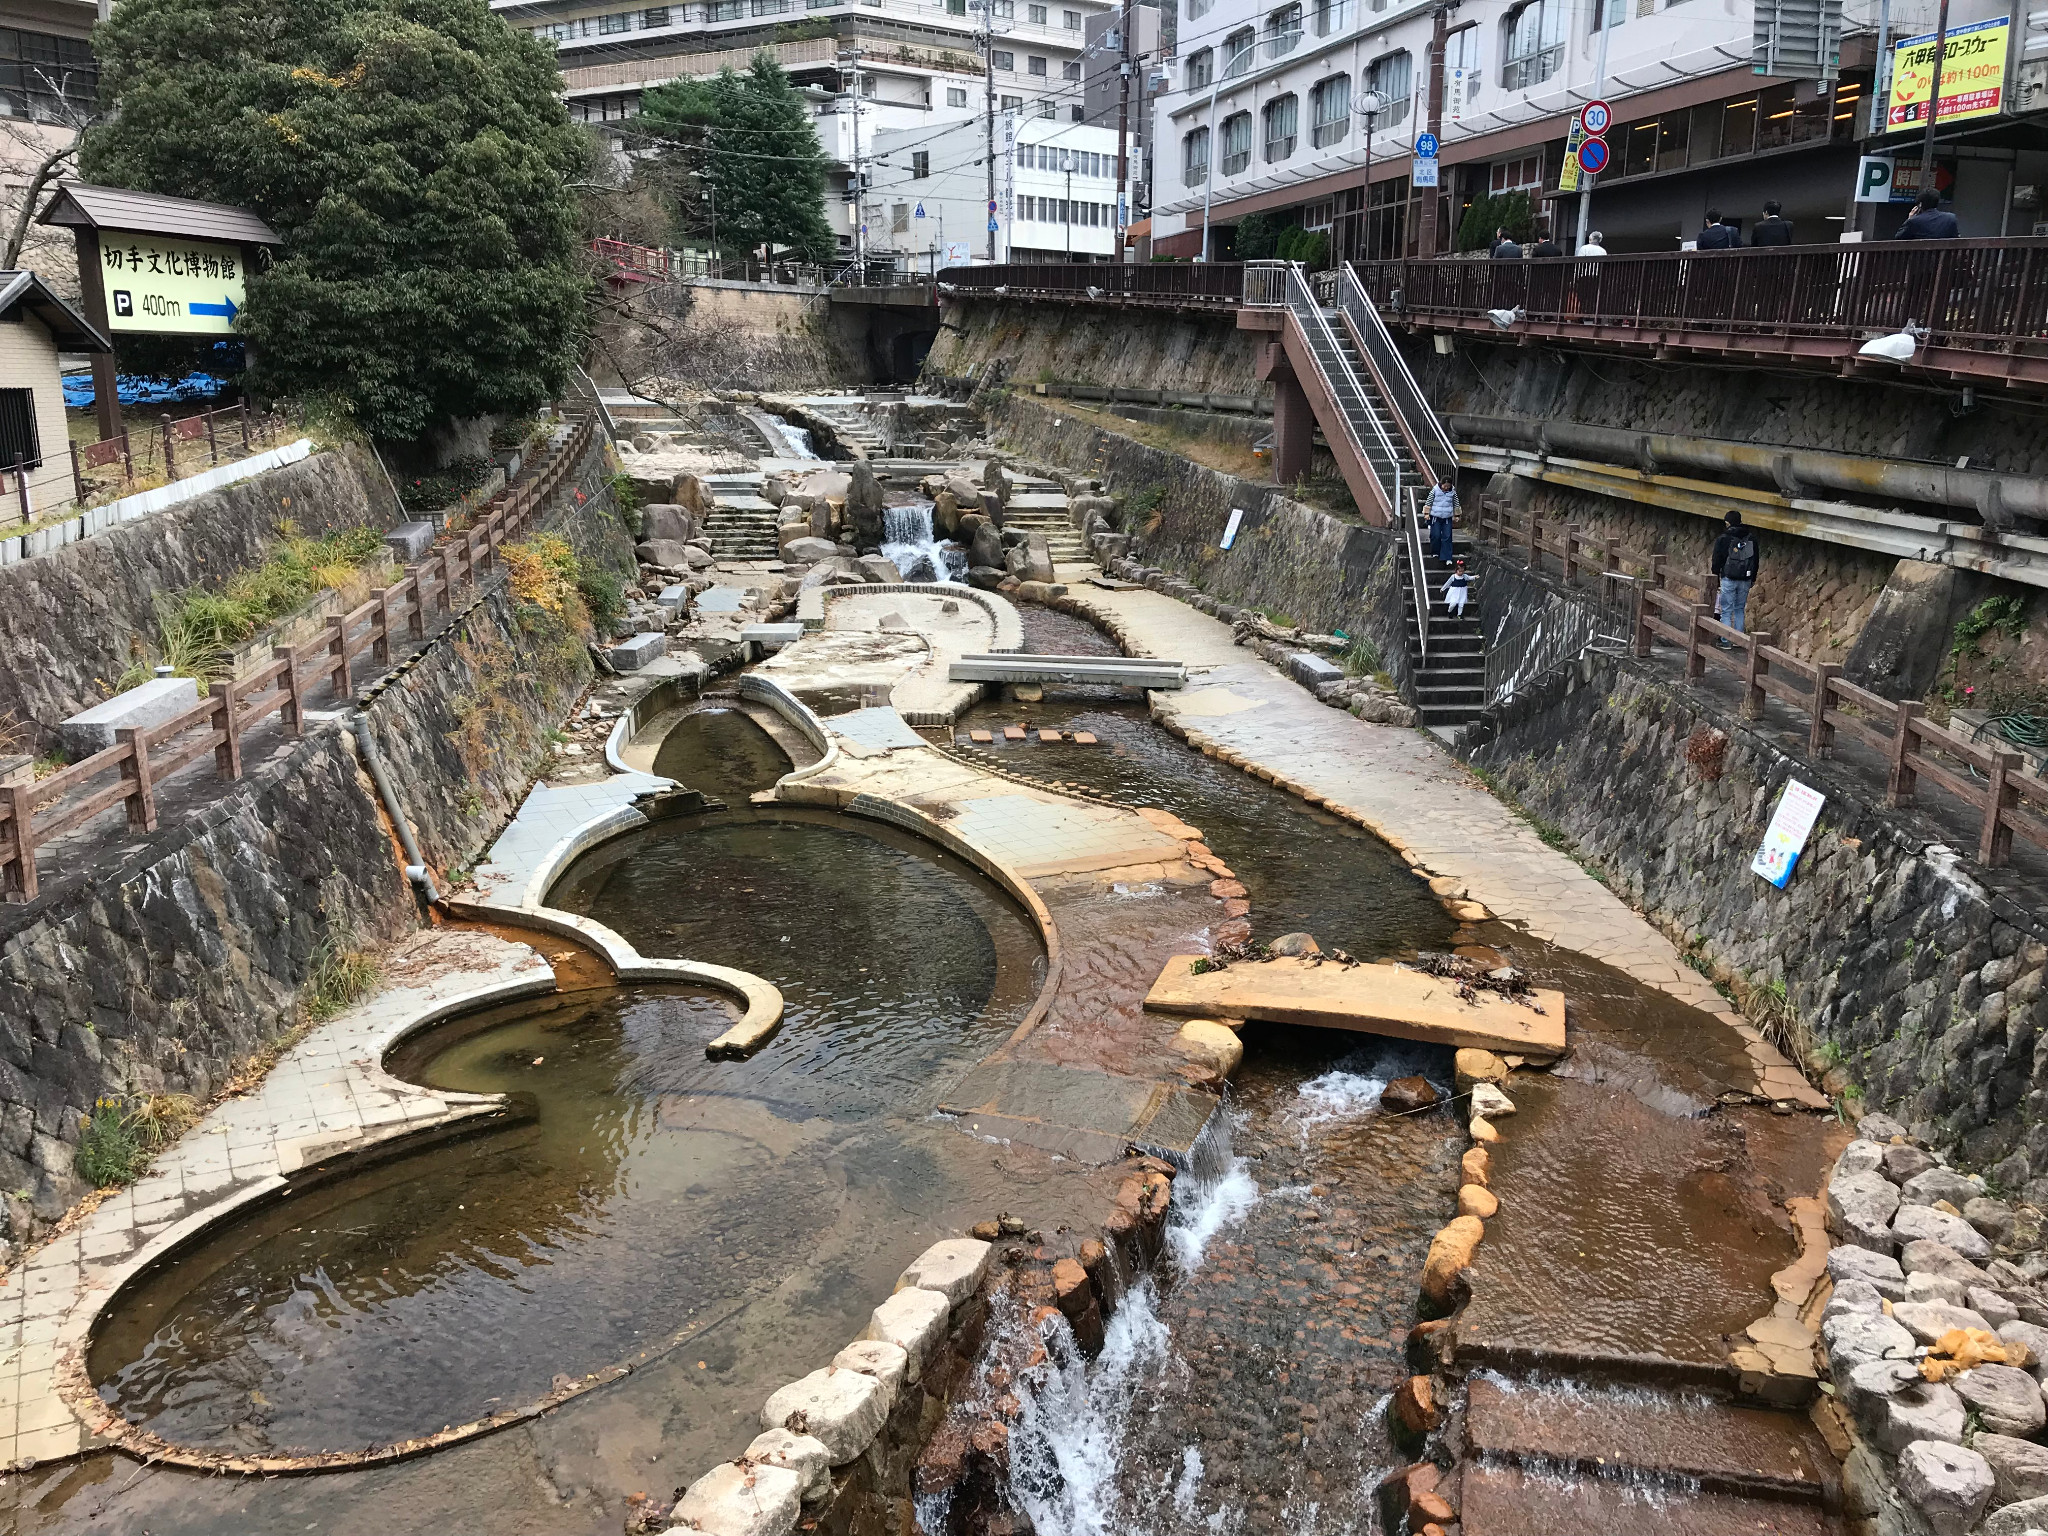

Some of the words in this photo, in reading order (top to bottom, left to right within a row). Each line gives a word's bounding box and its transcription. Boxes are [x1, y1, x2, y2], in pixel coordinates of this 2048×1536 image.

[1452, 79, 1463, 114] 有馬御苑
[1921, 89, 1997, 109] ロウェー専用駐車場は、
[1587, 110, 1605, 126] 30
[1920, 98, 1994, 118] ここら約1100m先です。
[1572, 120, 1580, 132] P
[1420, 140, 1433, 151] 98
[1415, 175, 1436, 184] 有馬町
[1419, 168, 1433, 176] 北区
[1861, 161, 1890, 197] P
[103, 244, 236, 281] 切手文化博物館
[116, 293, 130, 313] P
[142, 294, 181, 317] 400m
